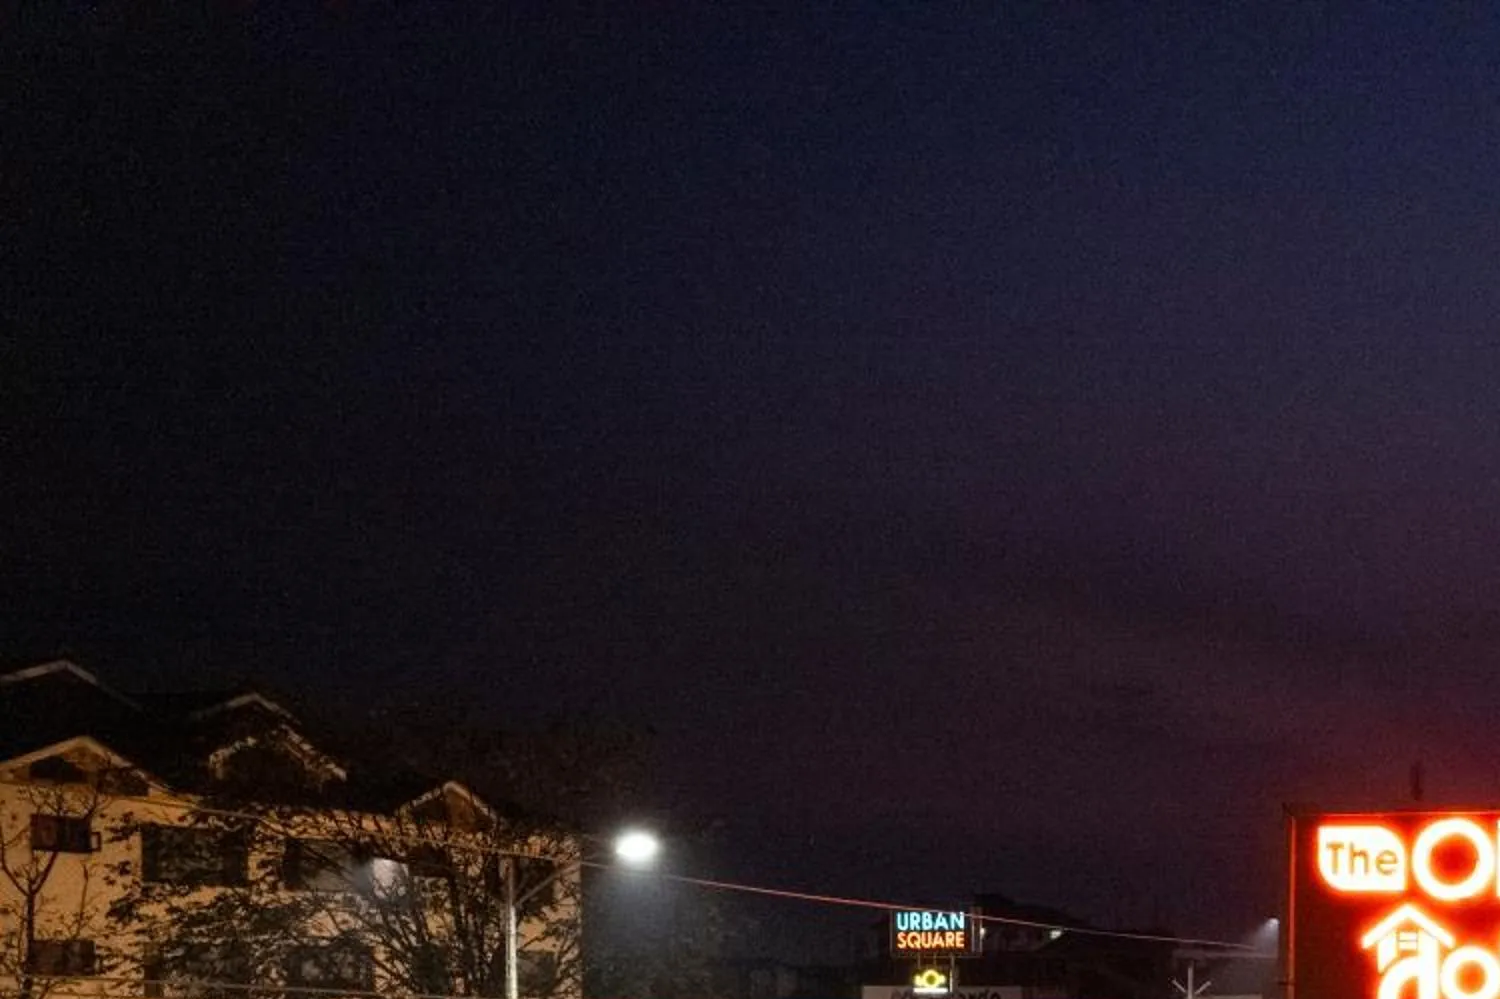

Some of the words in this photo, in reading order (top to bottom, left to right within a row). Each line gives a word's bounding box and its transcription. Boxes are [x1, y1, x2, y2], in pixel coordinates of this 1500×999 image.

[1326, 842, 1400, 876] The
[896, 911, 965, 931] URBAN
[897, 931, 965, 949] SQUARE
